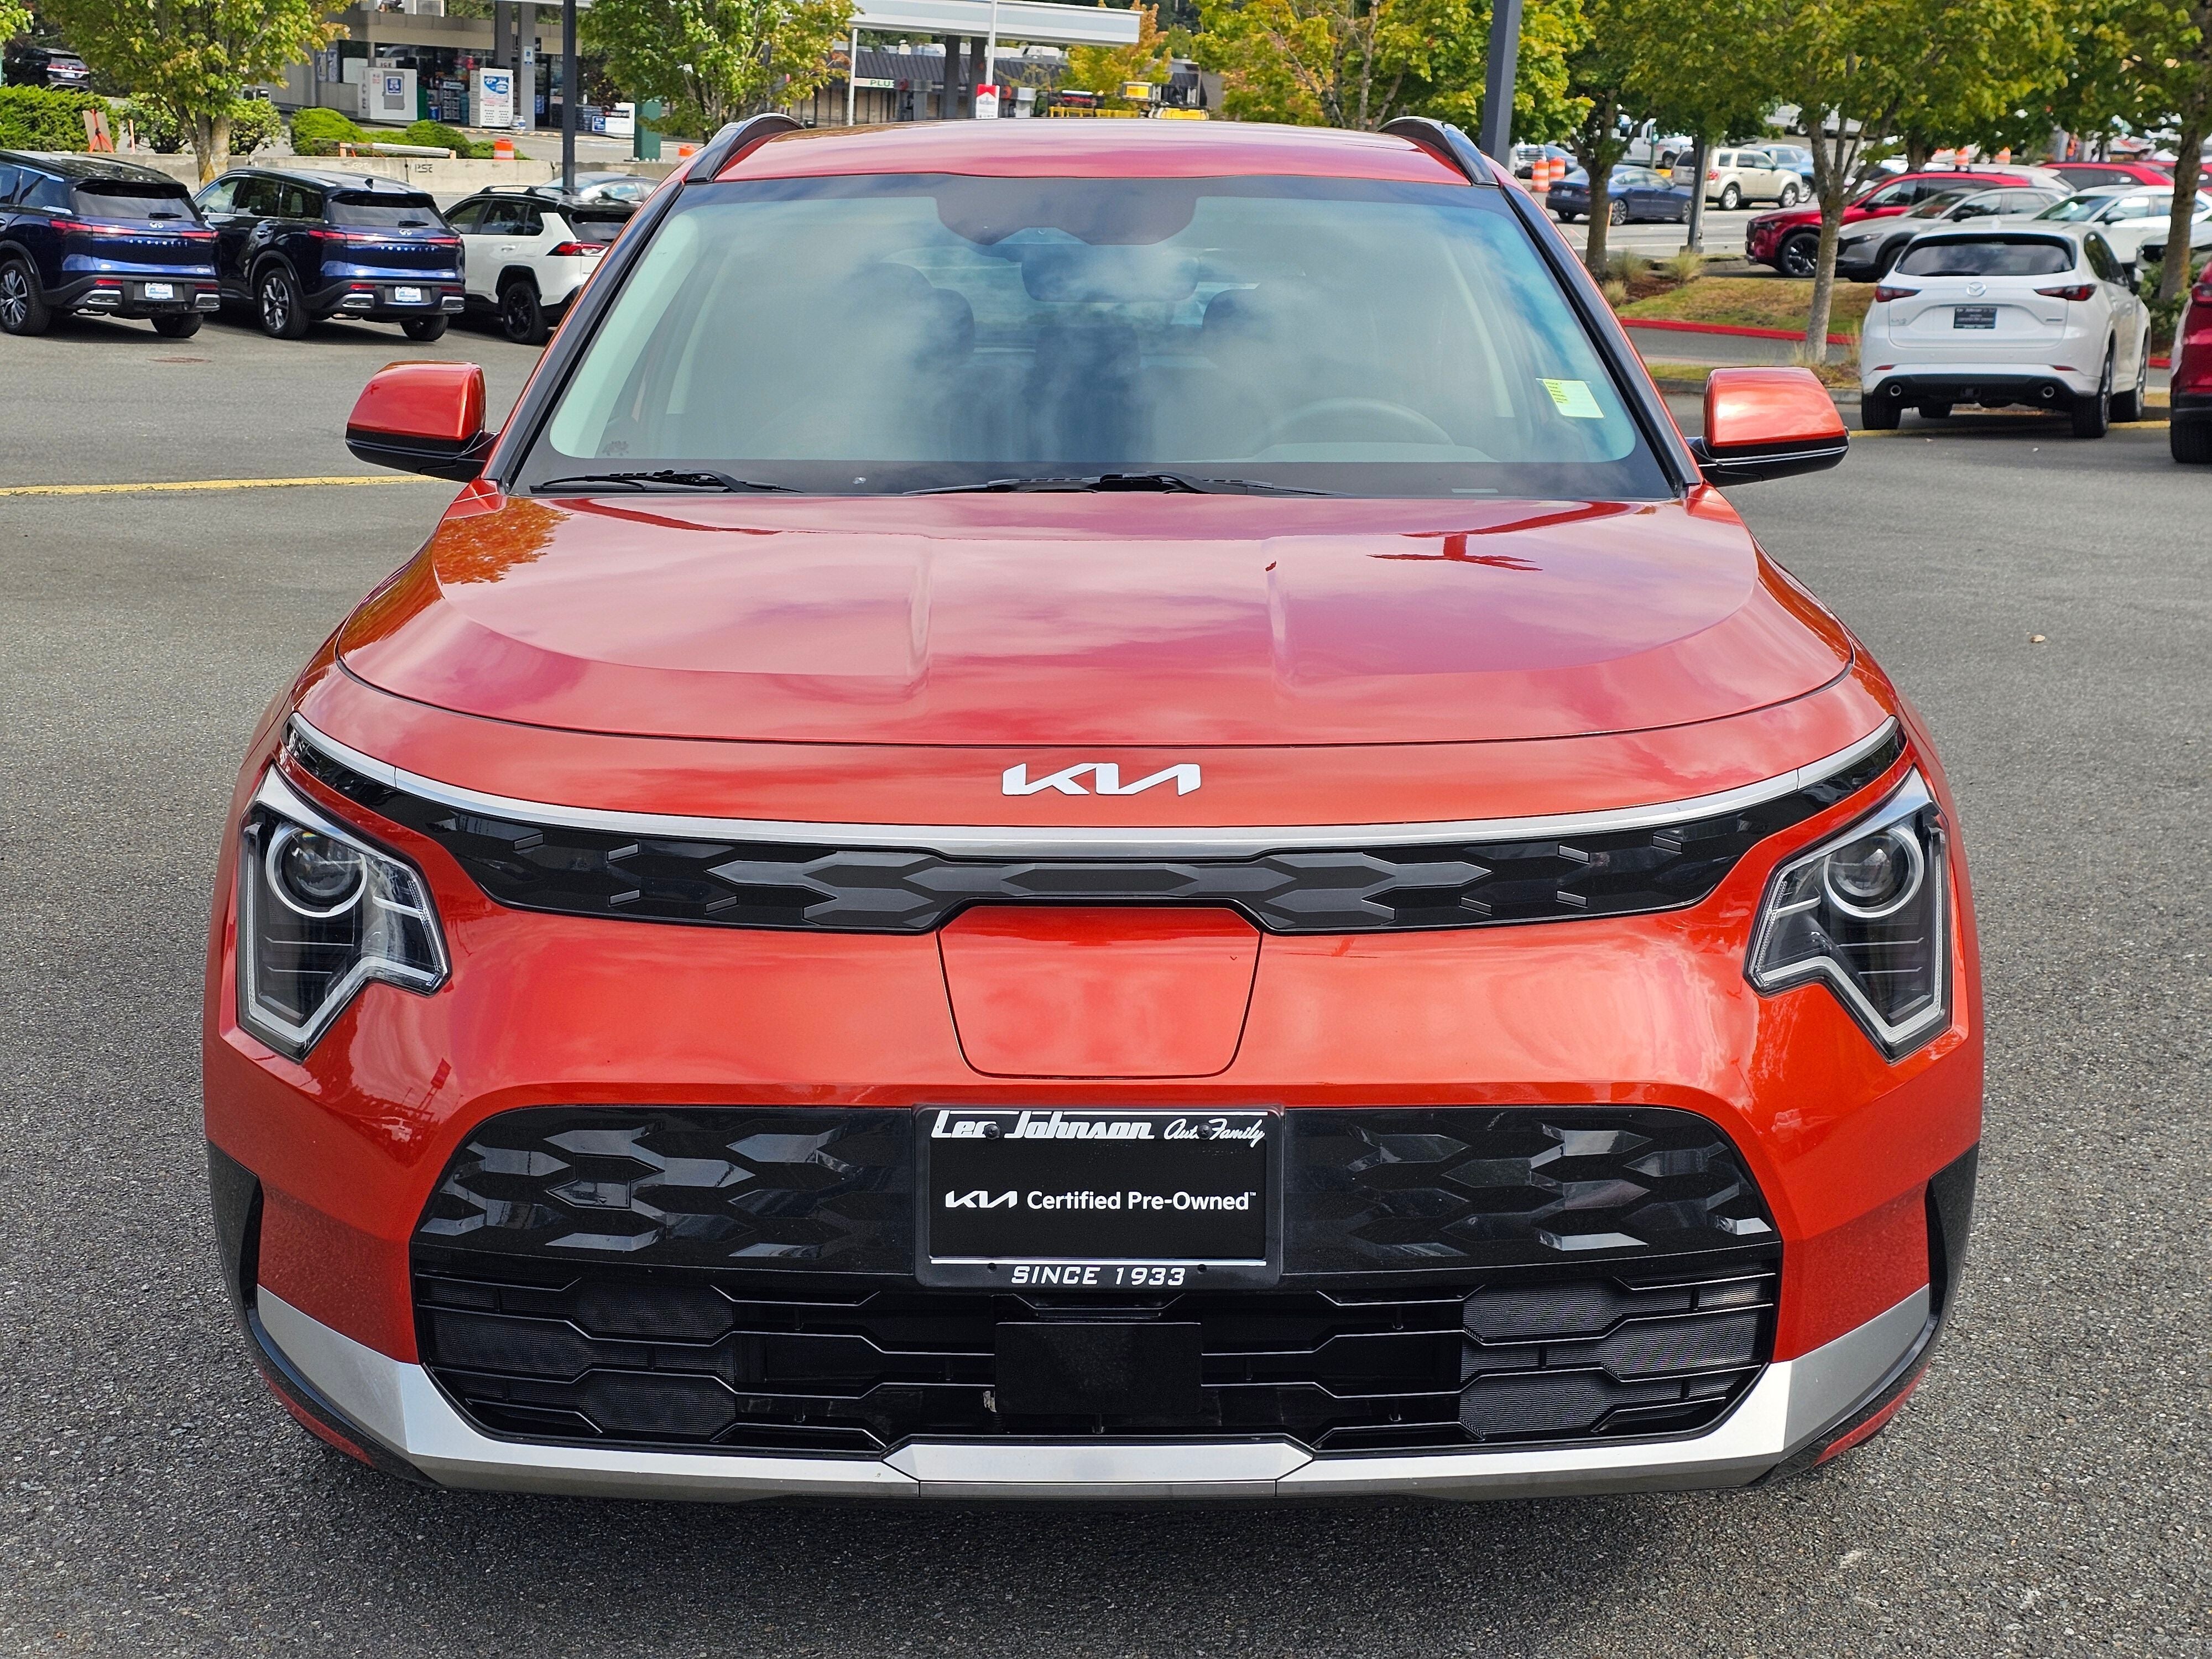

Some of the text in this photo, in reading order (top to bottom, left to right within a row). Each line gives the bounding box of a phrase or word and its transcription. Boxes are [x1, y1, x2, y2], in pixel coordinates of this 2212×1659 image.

[1004, 1111, 1155, 1139] Johnson
[1164, 1118, 1203, 1140] Aut
[1208, 1118, 1265, 1147] Family
[1027, 1191, 1121, 1209] Certified
[1011, 1266, 1186, 1286] SINCE 1933
